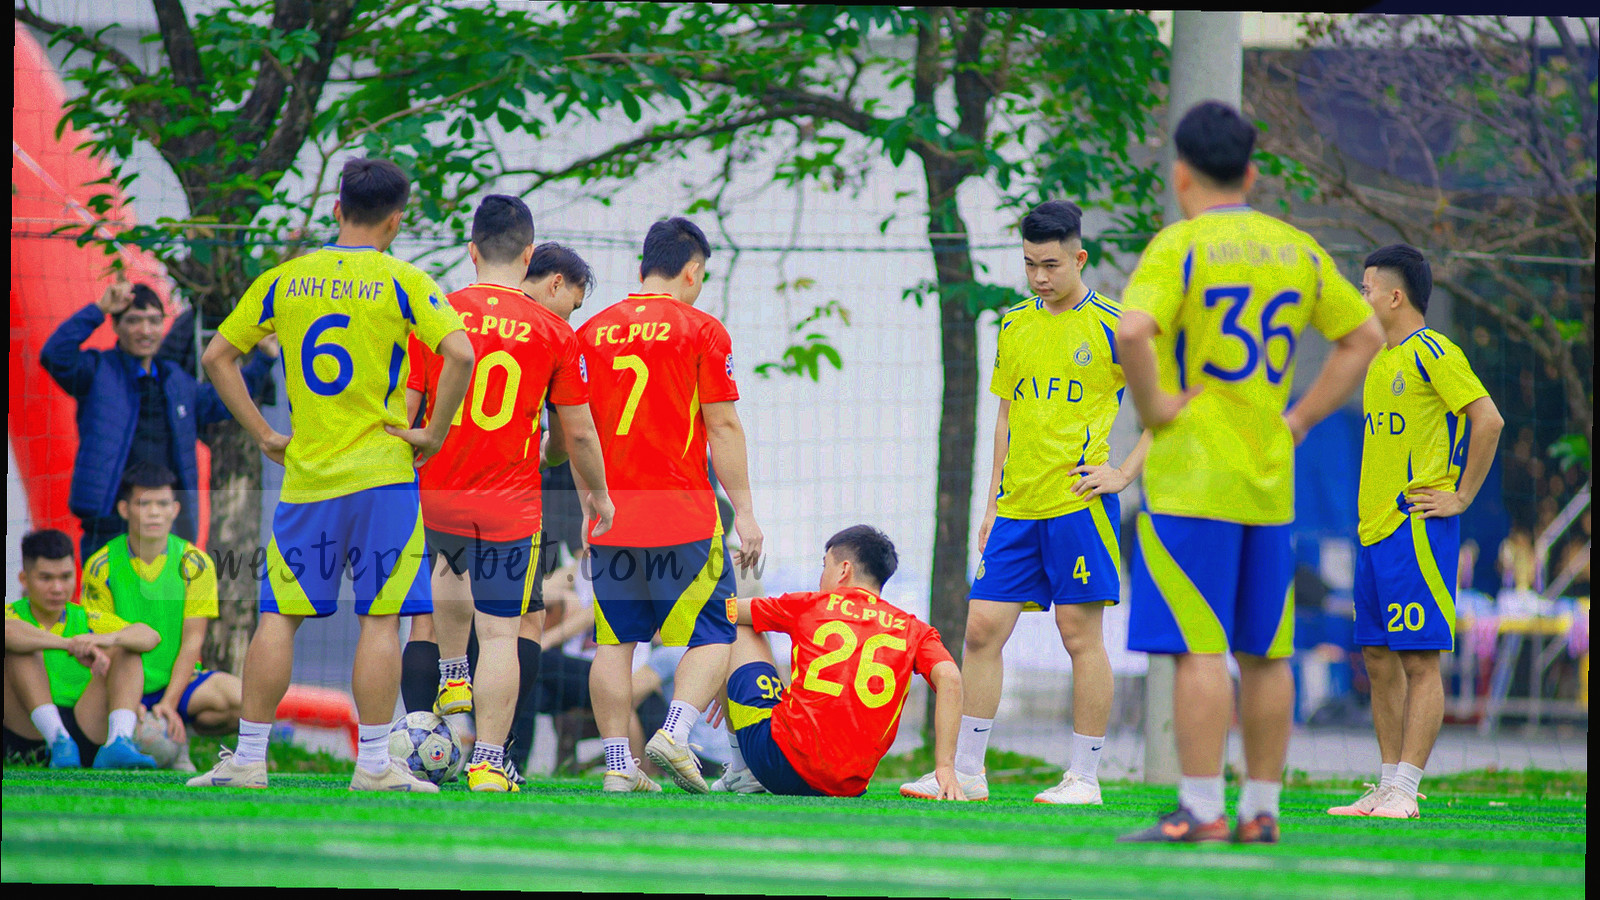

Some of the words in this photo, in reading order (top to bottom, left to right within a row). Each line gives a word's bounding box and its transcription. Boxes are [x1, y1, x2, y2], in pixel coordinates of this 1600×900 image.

[285, 277, 326, 298] ANH
[330, 279, 353, 300] EM
[358, 280, 384, 301] WF
[457, 311, 532, 342] C.PU2
[594, 322, 671, 347] FC.PU2
[1202, 285, 1302, 385] 36
[301, 313, 354, 397] 6
[450, 350, 522, 432] 0
[612, 354, 649, 436] 7
[1072, 555, 1091, 585] 4
[1387, 602, 1426, 632] 20
[803, 620, 907, 709] 26
